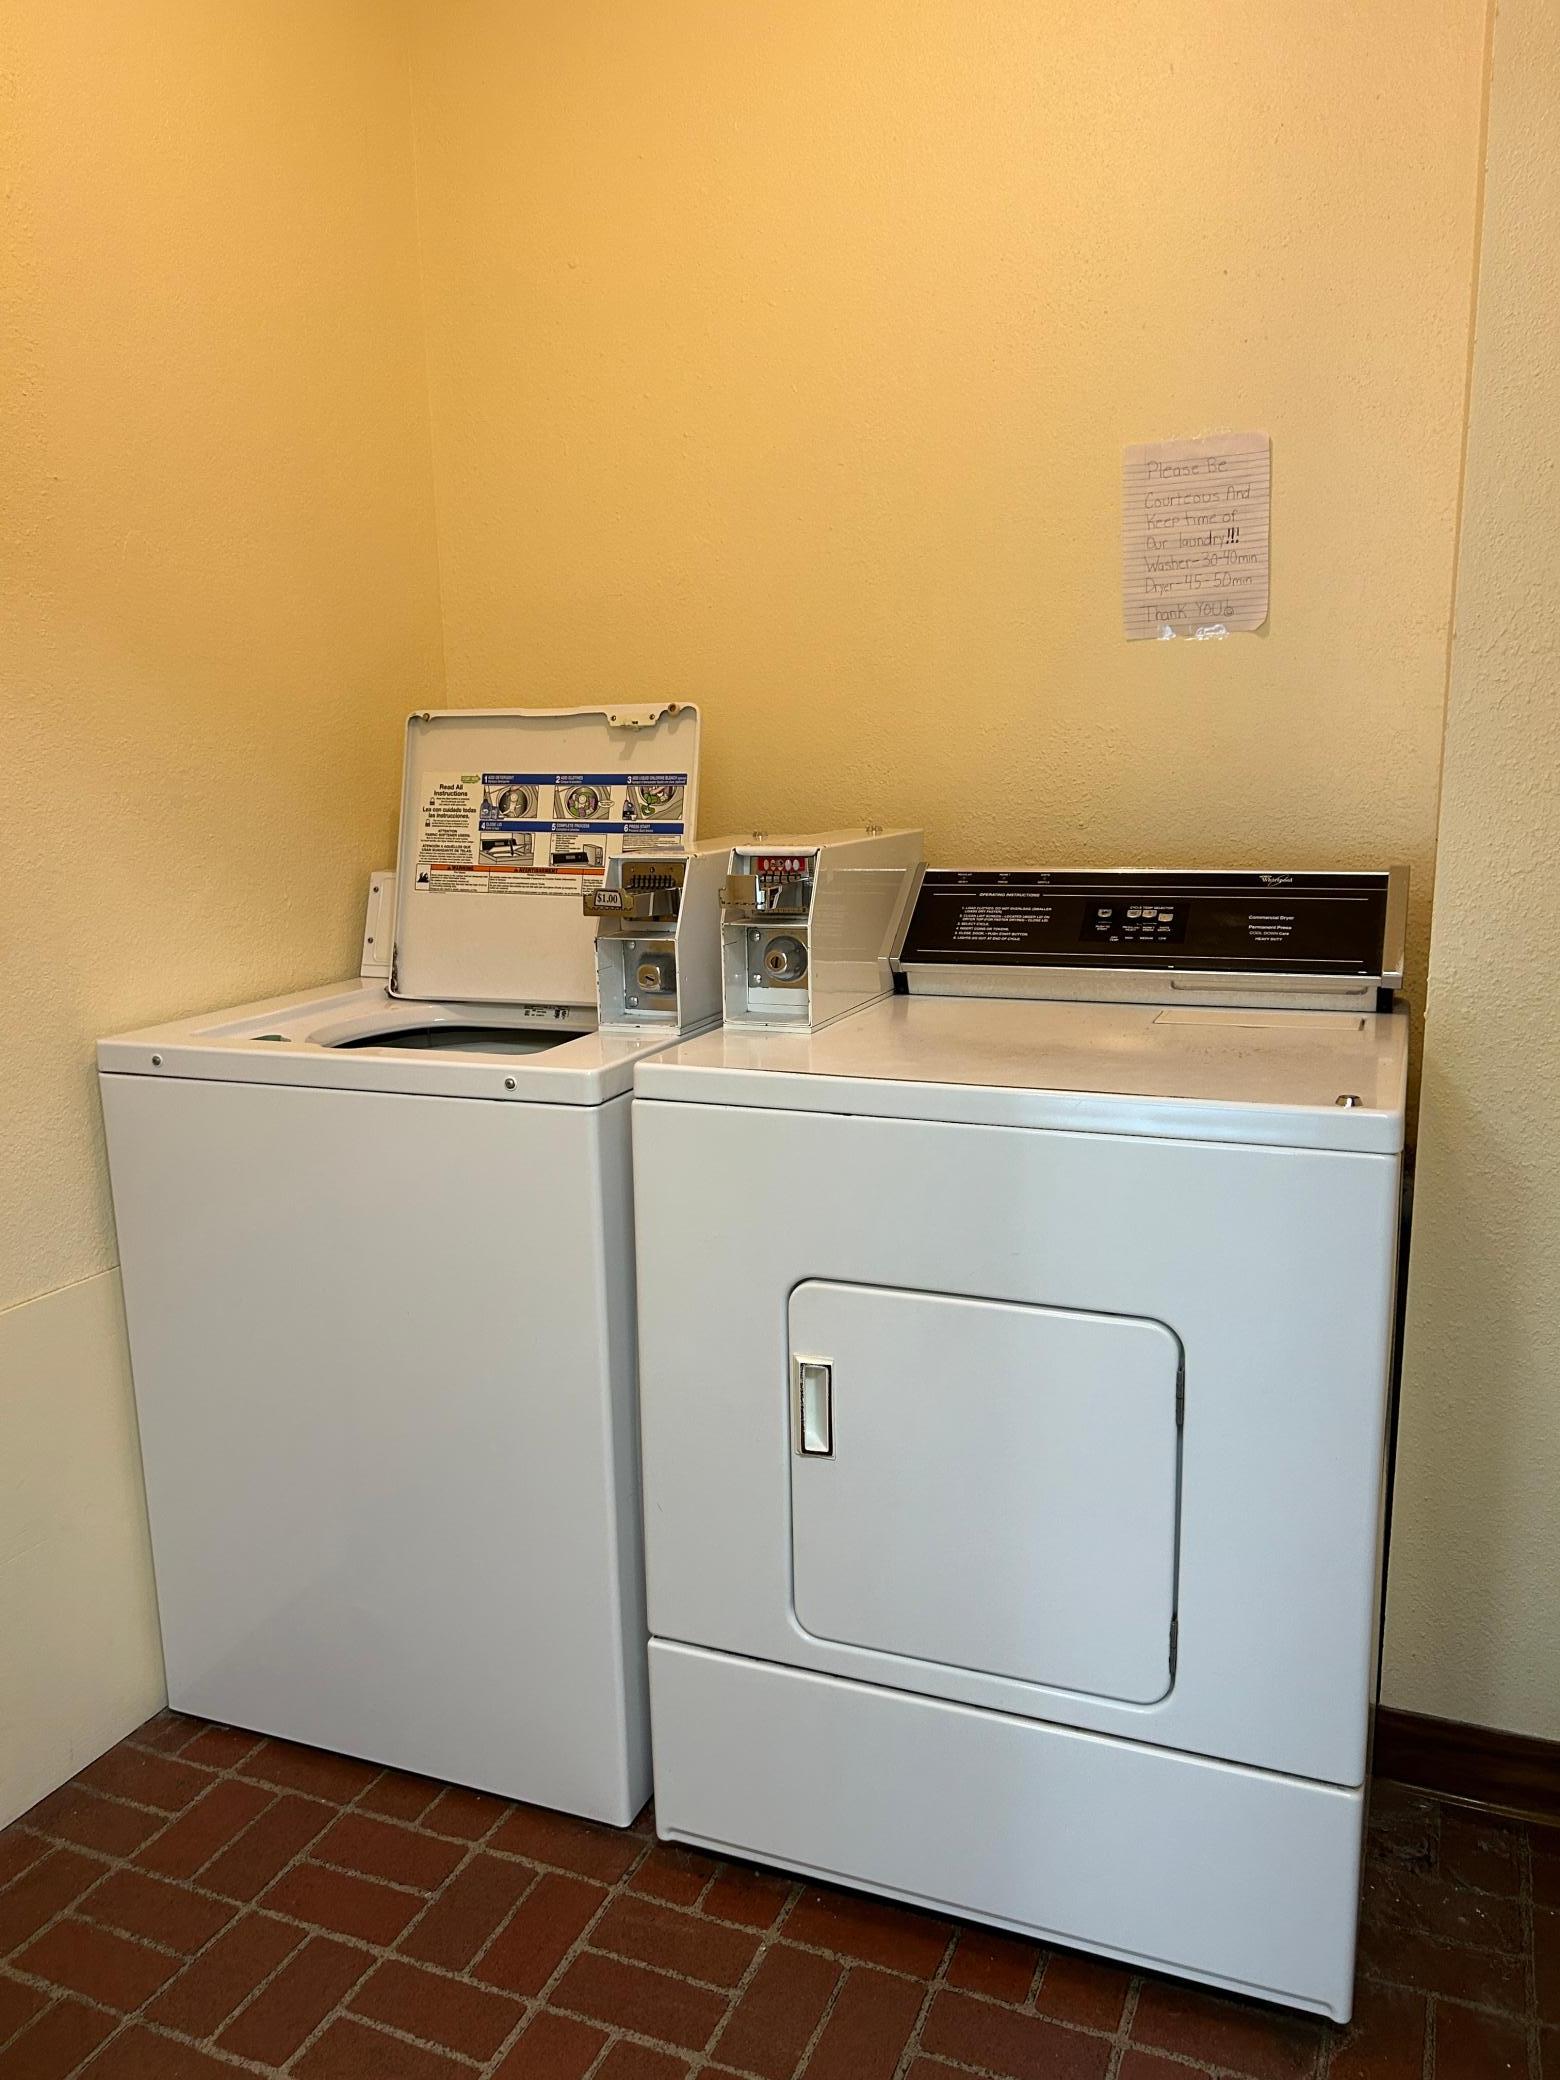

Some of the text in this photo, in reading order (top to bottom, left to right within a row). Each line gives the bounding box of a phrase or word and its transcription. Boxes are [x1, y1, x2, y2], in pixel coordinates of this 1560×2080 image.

[1147, 457, 1227, 480] Please Be
[1144, 483, 1251, 509] Courteous And
[1186, 512, 1217, 526] time
[1222, 510, 1239, 523] of
[627, 776, 632, 784] 3
[481, 823, 486, 831] 4
[551, 823, 556, 831] 5
[624, 824, 629, 832] 6
[597, 893, 618, 903] $1.00
